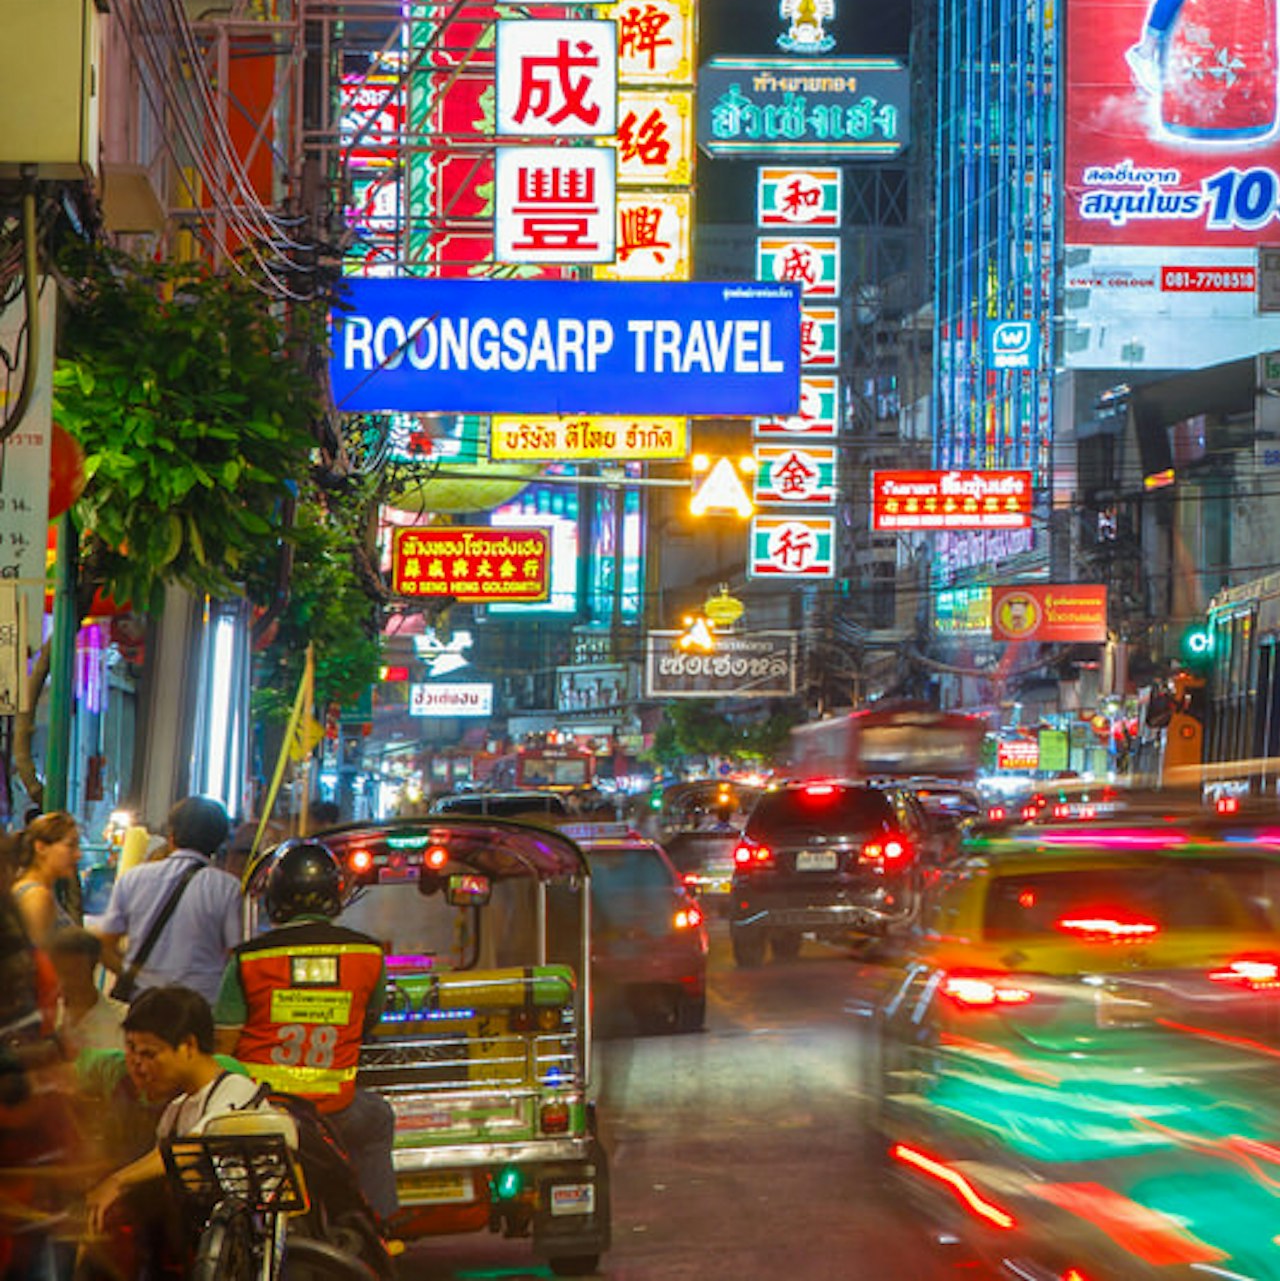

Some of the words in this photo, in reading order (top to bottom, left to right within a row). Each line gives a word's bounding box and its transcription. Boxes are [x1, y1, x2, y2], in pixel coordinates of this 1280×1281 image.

[1083, 186, 1201, 221] สมุนไพร
[1205, 169, 1274, 222] 10
[343, 316, 614, 373] ROONGSARP
[628, 319, 785, 374] TRAVEL
[772, 178, 822, 568] 和成金行
[271, 1023, 338, 1069] 38
